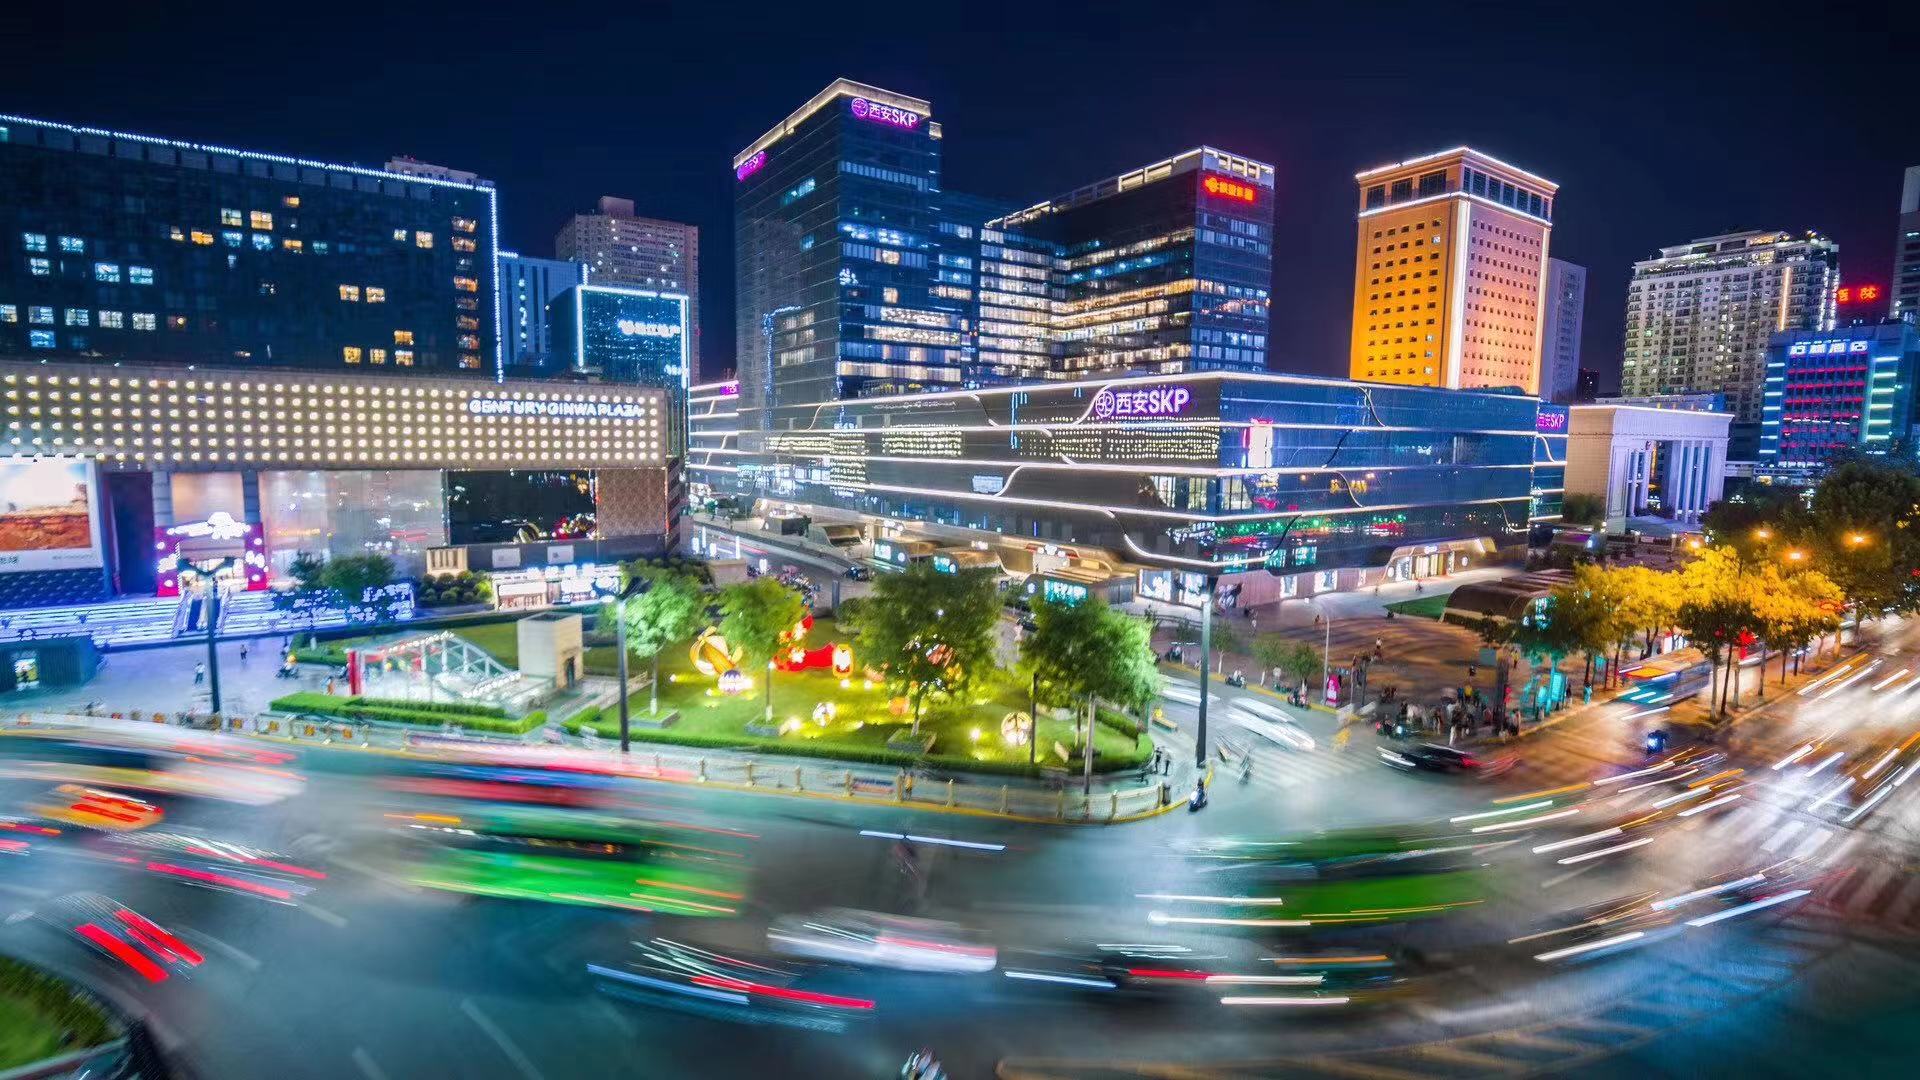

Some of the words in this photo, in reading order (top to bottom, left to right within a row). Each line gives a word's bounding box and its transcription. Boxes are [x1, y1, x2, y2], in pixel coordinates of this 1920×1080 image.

[868, 102, 919, 127] 西安SKP
[469, 399, 545, 415] CENTURY
[597, 403, 642, 417] PLAZA
[1116, 387, 1190, 414] 西安SKP
